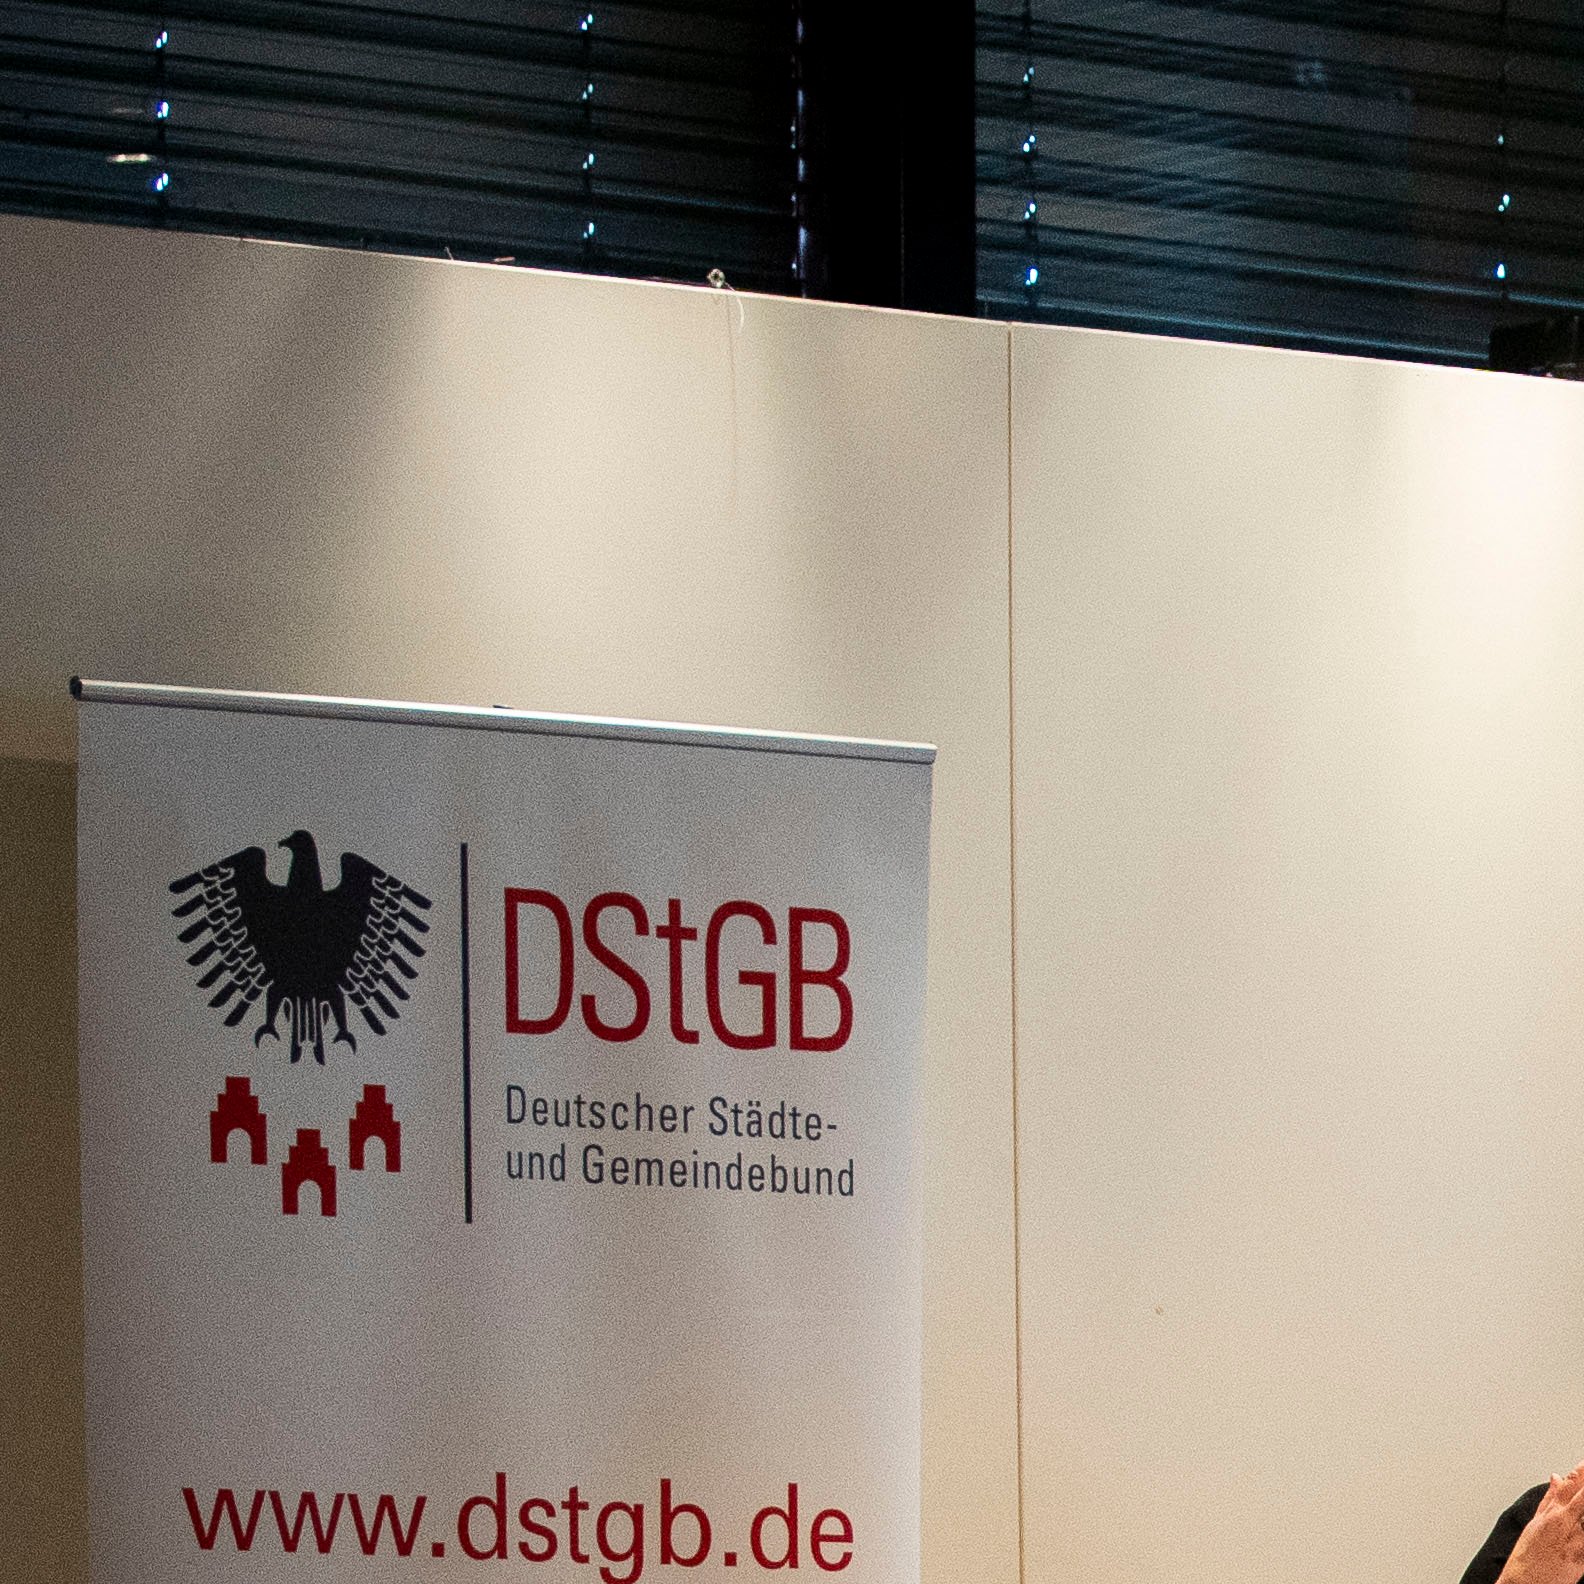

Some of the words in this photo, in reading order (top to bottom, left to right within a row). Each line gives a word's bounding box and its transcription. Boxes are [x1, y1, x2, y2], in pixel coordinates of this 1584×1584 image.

[504, 887, 852, 1051] DStGB
[506, 1084, 693, 1133] Deutscher
[709, 1096, 838, 1142] Städte-
[505, 1144, 567, 1184] und
[581, 1146, 856, 1198] Gemeindebund
